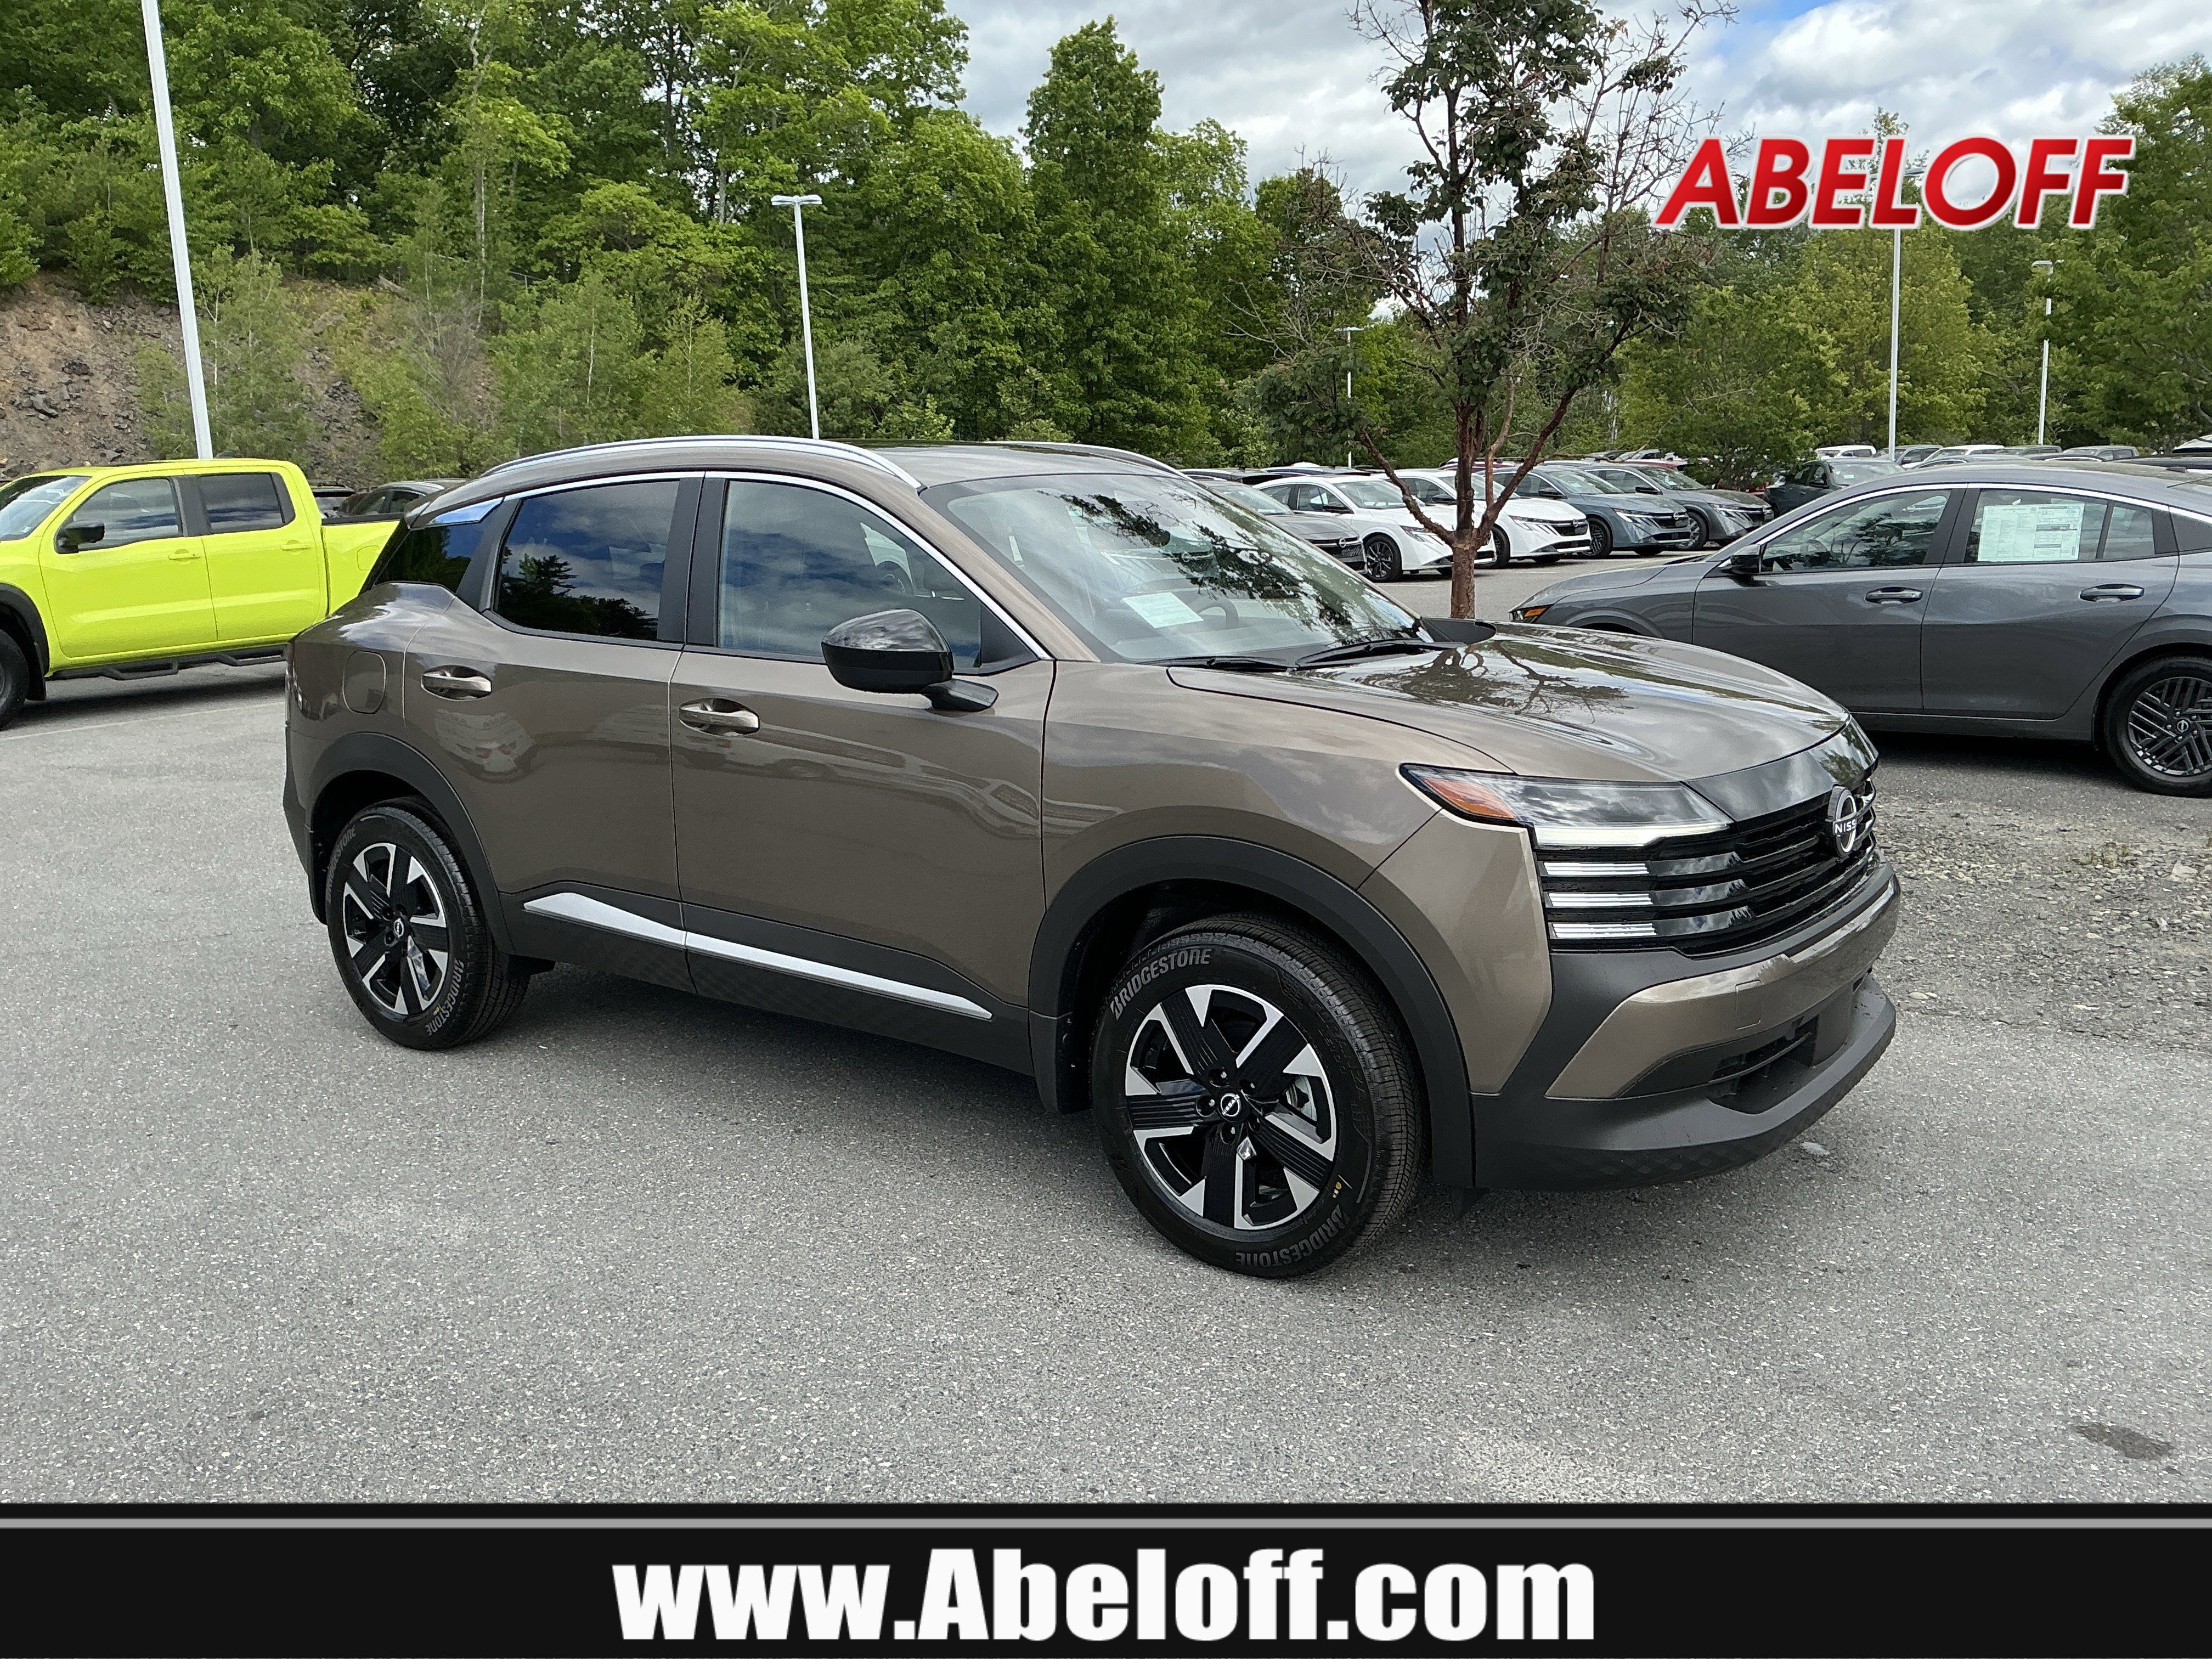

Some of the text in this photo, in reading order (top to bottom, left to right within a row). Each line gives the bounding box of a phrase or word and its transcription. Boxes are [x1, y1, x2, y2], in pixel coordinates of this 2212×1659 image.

[424, 958, 465, 1037] BRIDGESTONE
[1109, 947, 1212, 1022] BRIDGESTONE
[1235, 1204, 1350, 1271] BRIDGESTONE
